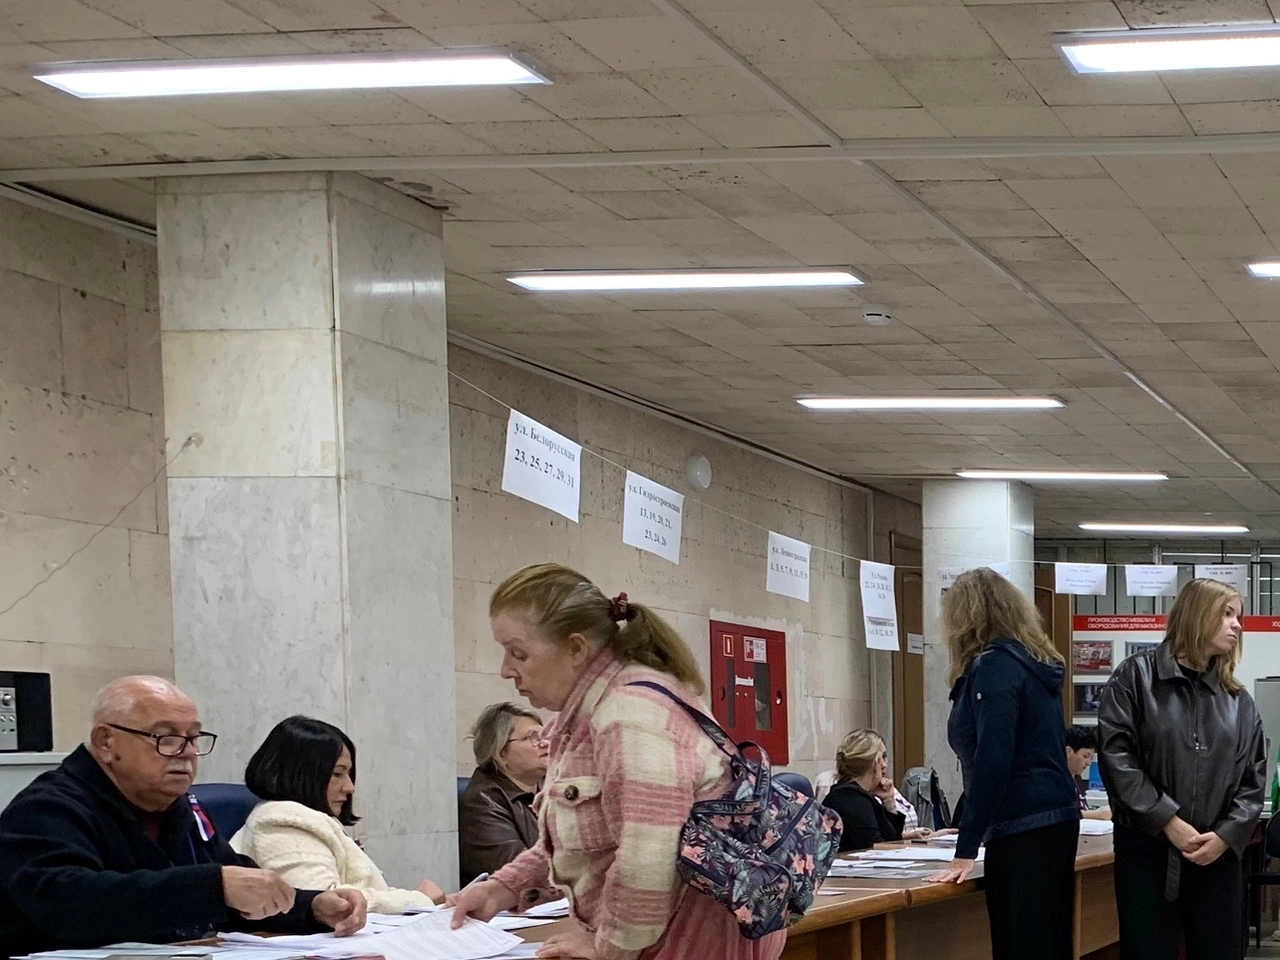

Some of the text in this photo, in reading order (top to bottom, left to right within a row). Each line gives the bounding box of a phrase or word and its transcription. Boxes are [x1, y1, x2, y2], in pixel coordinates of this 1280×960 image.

[514, 423, 575, 462] ул. Белорусская
[514, 448, 528, 466] 23,
[530, 456, 542, 471] 25,
[544, 462, 555, 477] 27,
